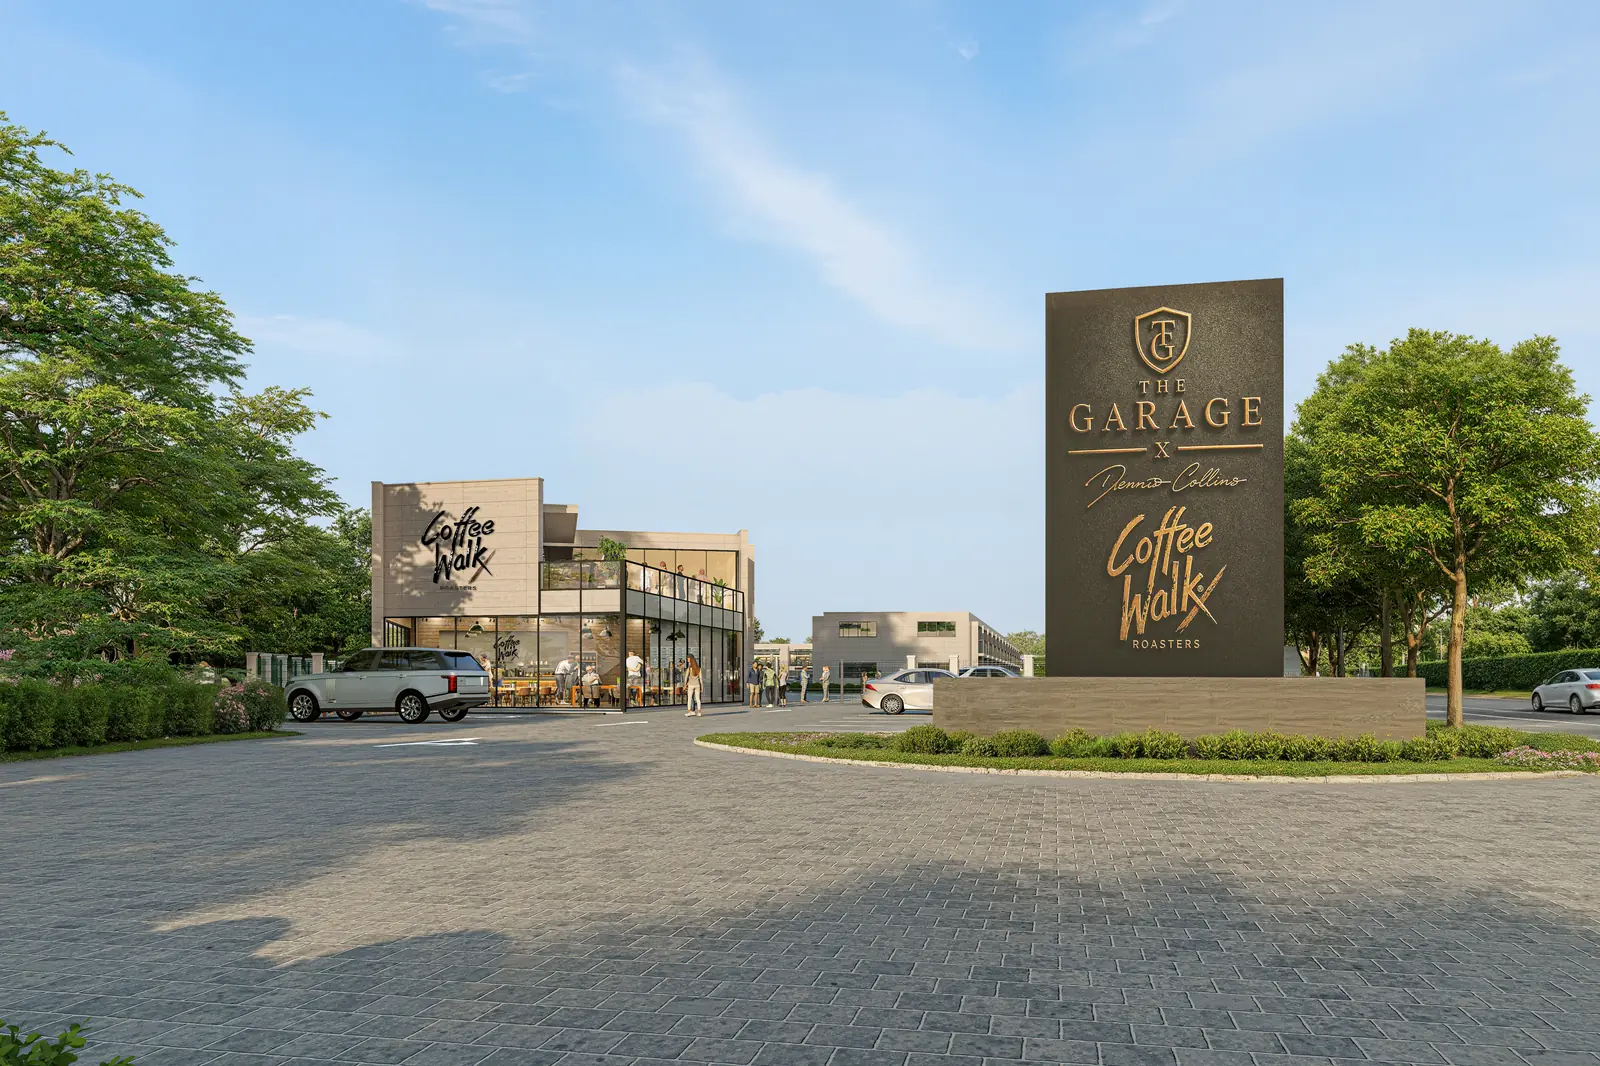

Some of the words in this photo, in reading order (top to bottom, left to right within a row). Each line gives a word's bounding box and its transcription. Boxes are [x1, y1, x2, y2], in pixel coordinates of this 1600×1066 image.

[1138, 378, 1186, 394] THE
[1068, 396, 1264, 434] GARAGE
[1154, 441, 1170, 458] X
[1172, 462, 1247, 492] Collins
[421, 506, 495, 553] Coffee
[1107, 505, 1213, 590] Coffee
[432, 537, 496, 584] Walk
[1119, 555, 1227, 641] Walk
[1132, 639, 1200, 649] ROASTERS
